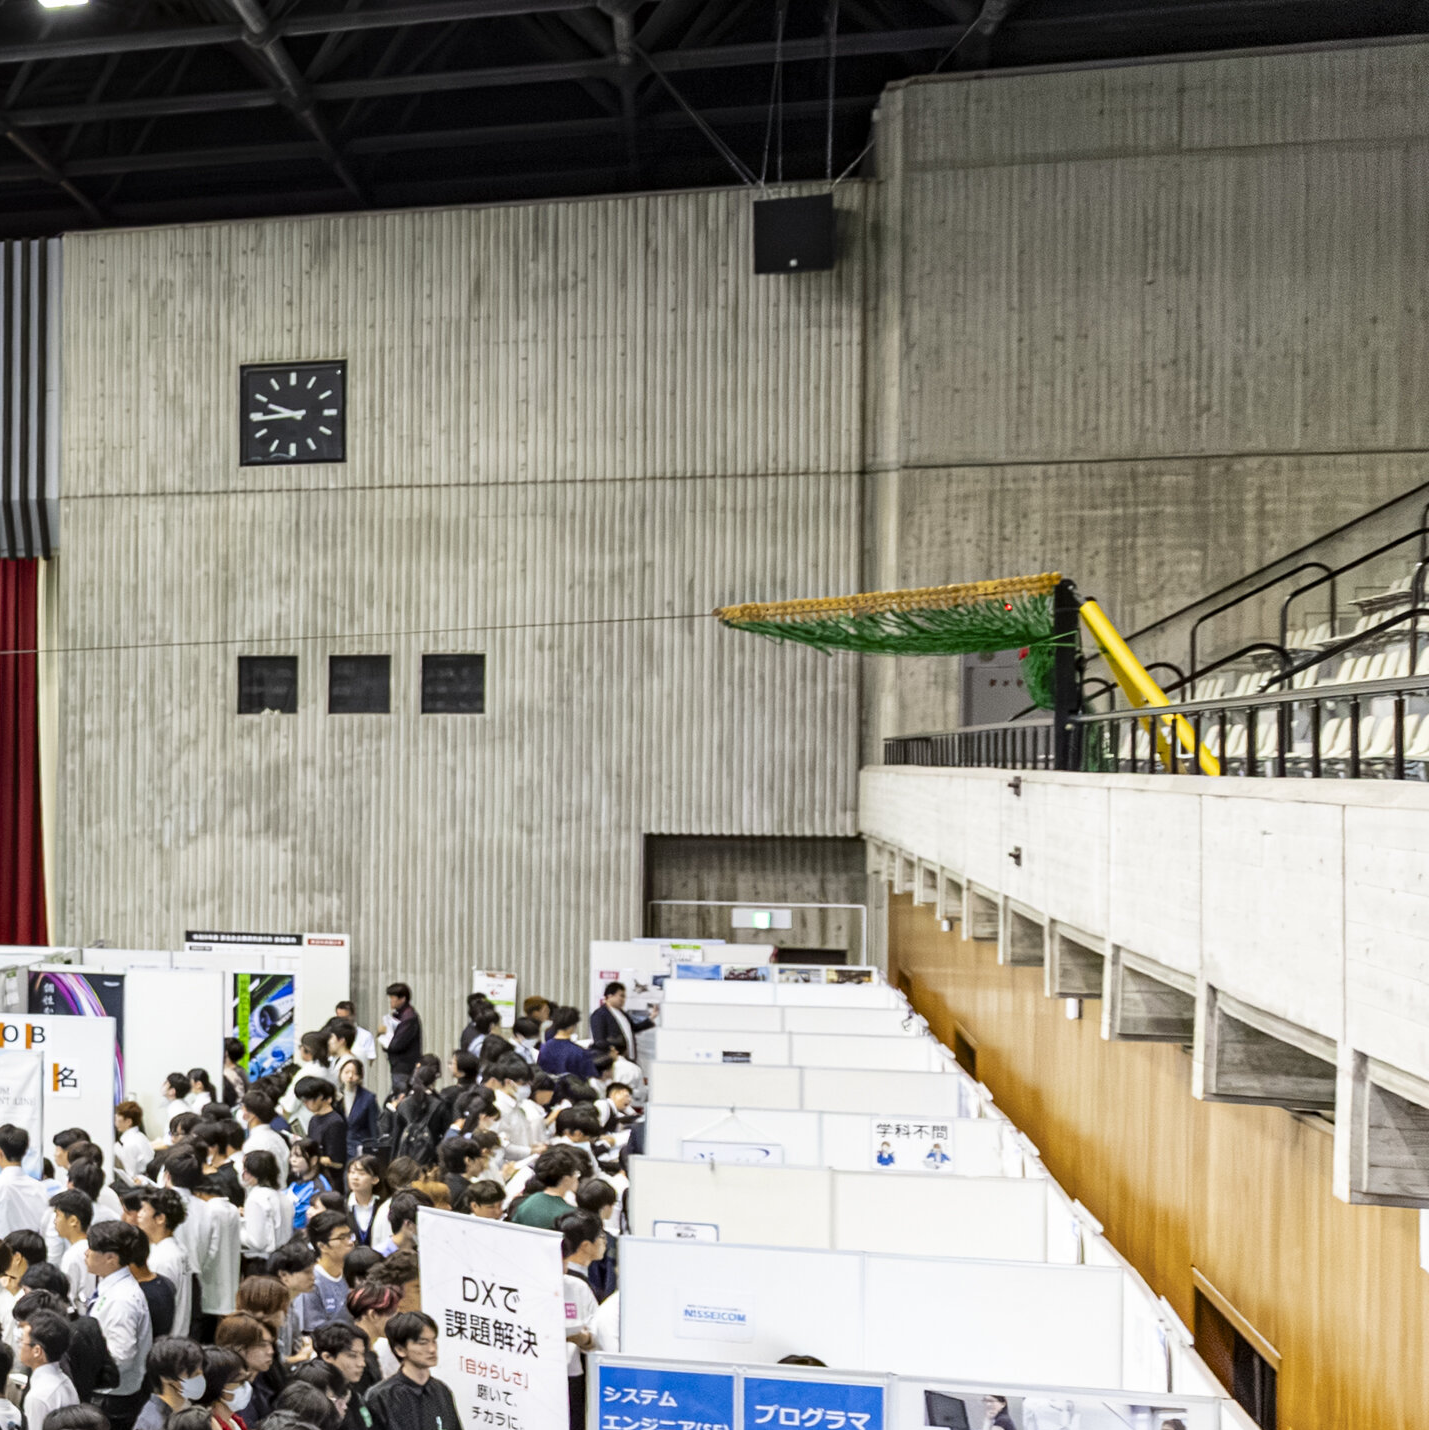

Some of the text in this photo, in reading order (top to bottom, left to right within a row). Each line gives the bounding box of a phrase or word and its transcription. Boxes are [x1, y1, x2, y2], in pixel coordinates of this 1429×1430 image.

[57, 1066, 78, 1089] 名
[877, 1122, 949, 1140] 学科不問
[462, 1276, 520, 1314] DXで
[445, 1309, 539, 1358] 課題解決
[603, 1386, 678, 1408] システム
